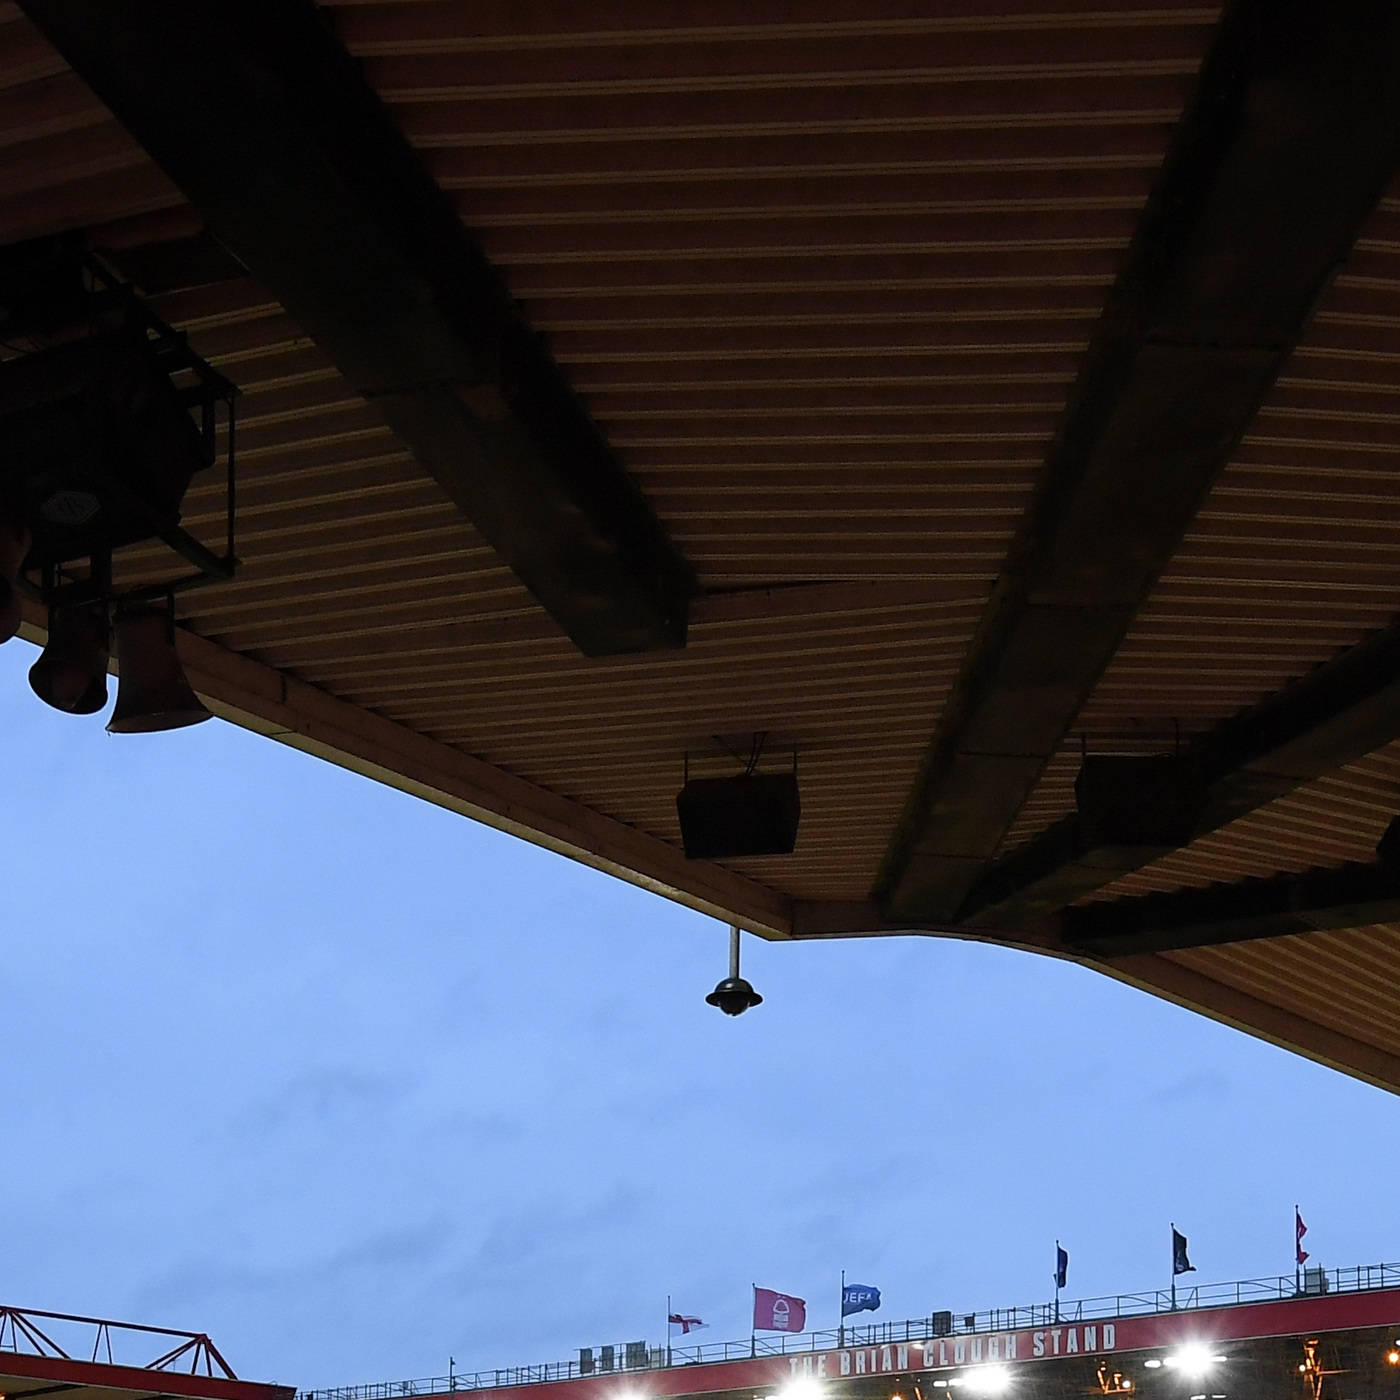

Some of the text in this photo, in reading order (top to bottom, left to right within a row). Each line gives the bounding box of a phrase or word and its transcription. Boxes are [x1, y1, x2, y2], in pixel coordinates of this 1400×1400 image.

[788, 1323, 1117, 1380] THE BRIAN CLOUGH STAND
